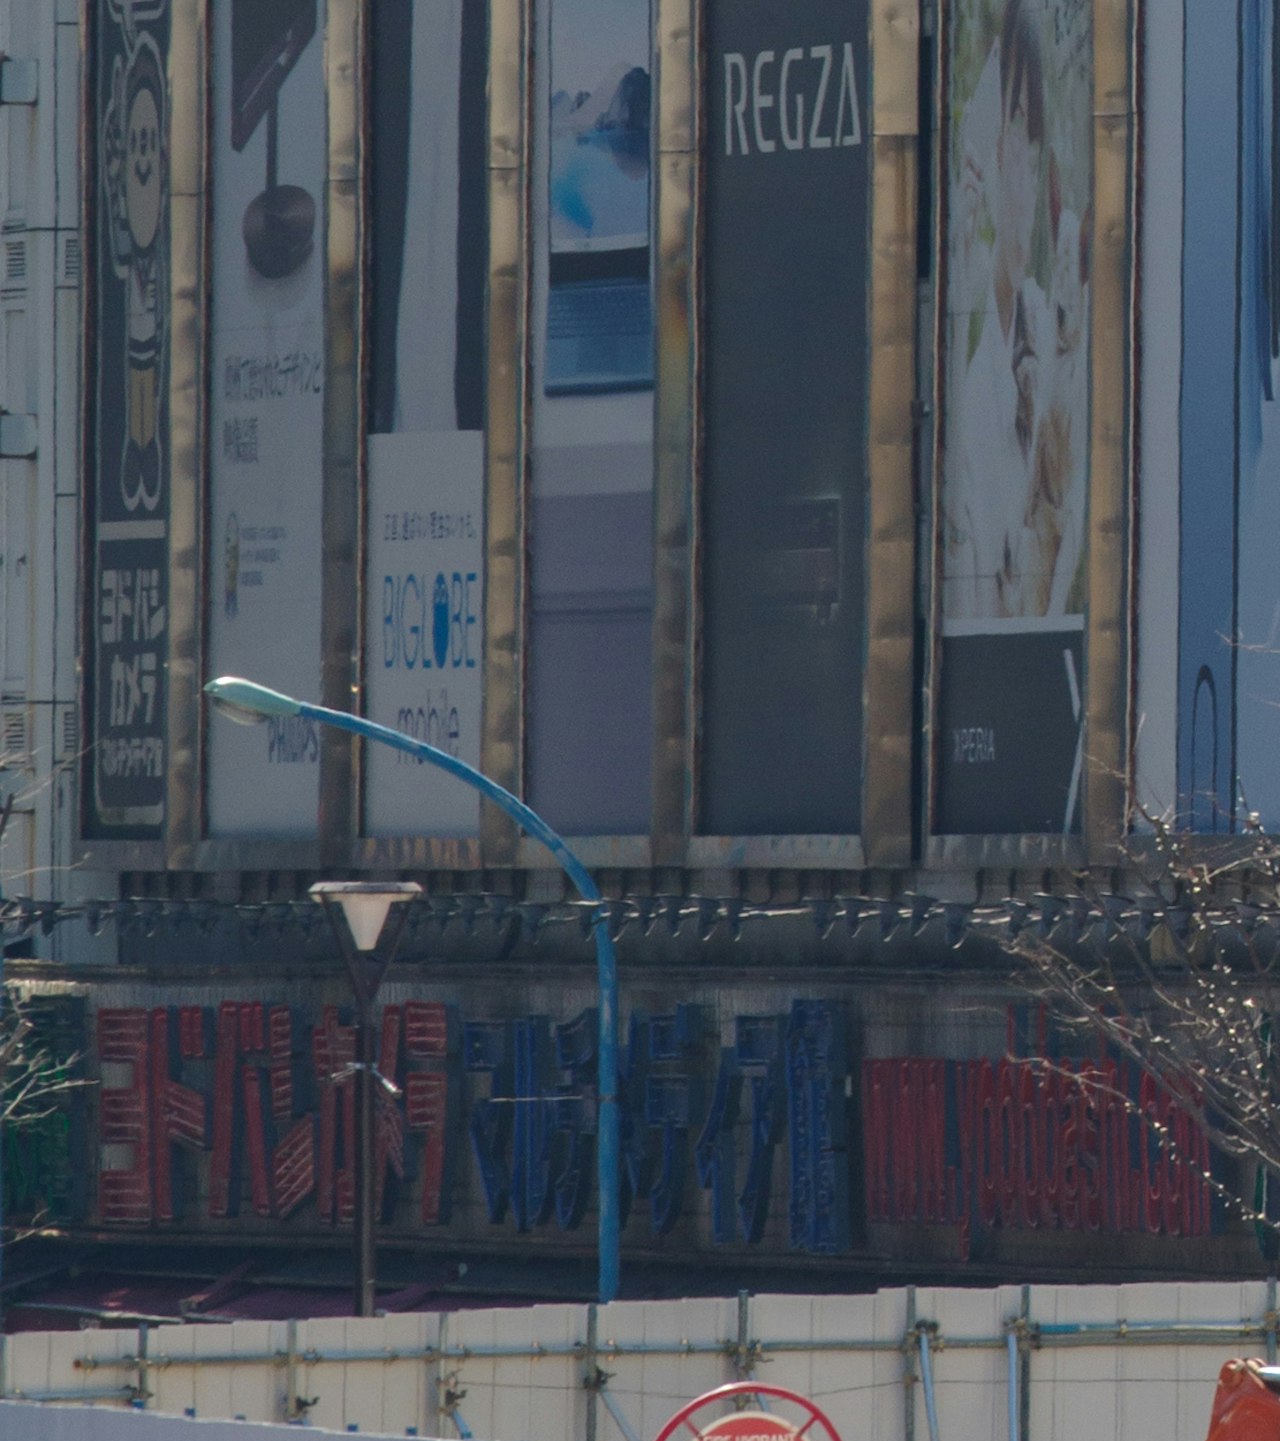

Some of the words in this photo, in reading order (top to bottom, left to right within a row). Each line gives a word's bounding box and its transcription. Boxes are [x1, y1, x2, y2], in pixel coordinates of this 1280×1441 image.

[724, 41, 862, 157] REGZA
[101, 567, 166, 643] ヨドバシ
[383, 571, 477, 669] BIGLOBE
[110, 652, 157, 727] カメラ
[98, 999, 448, 1228] ヨドバシカメラ
